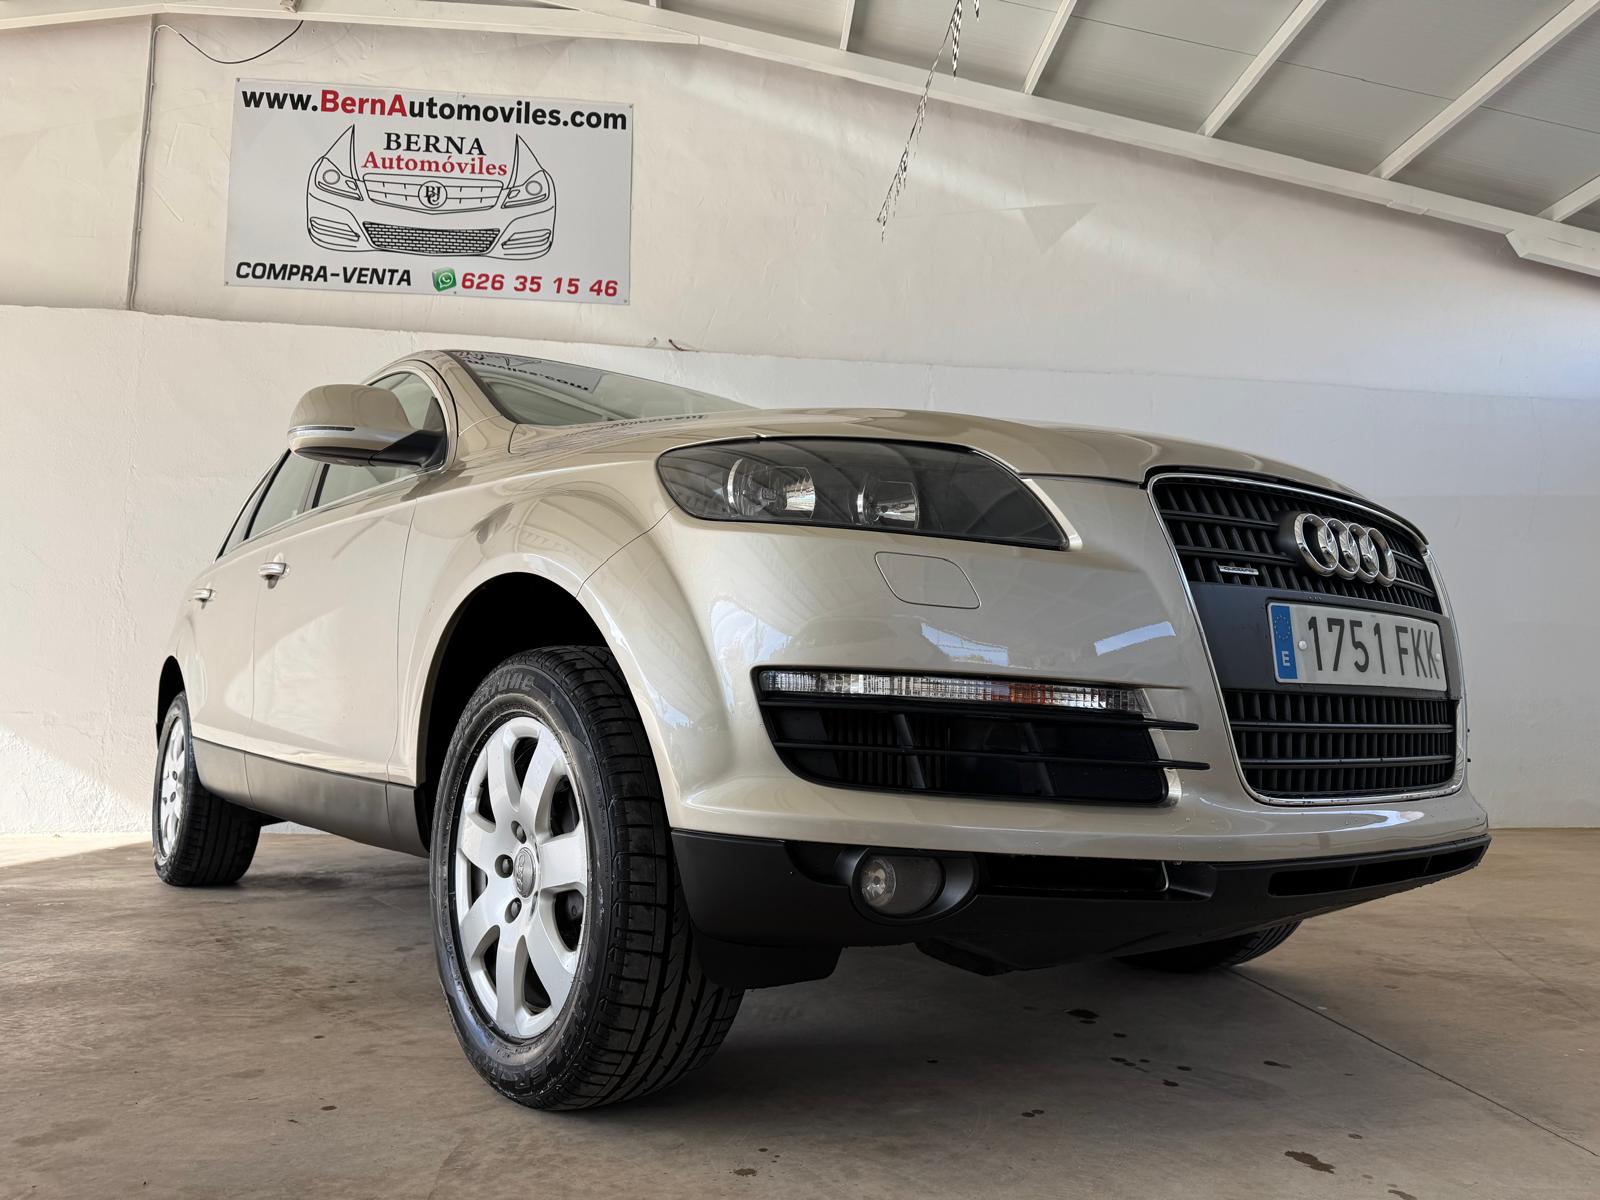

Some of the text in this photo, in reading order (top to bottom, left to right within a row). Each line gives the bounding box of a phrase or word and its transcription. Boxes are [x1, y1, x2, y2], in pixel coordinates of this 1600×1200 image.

[242, 90, 626, 130] www.BernAutomoviles.com
[384, 132, 486, 155] BERNA
[361, 152, 507, 175] Automóviles
[236, 261, 412, 286] COMPRA-VENTA
[462, 272, 618, 297] 626 35 15 46
[1282, 651, 1291, 667] E
[1309, 616, 1440, 679] 1751 FKK
